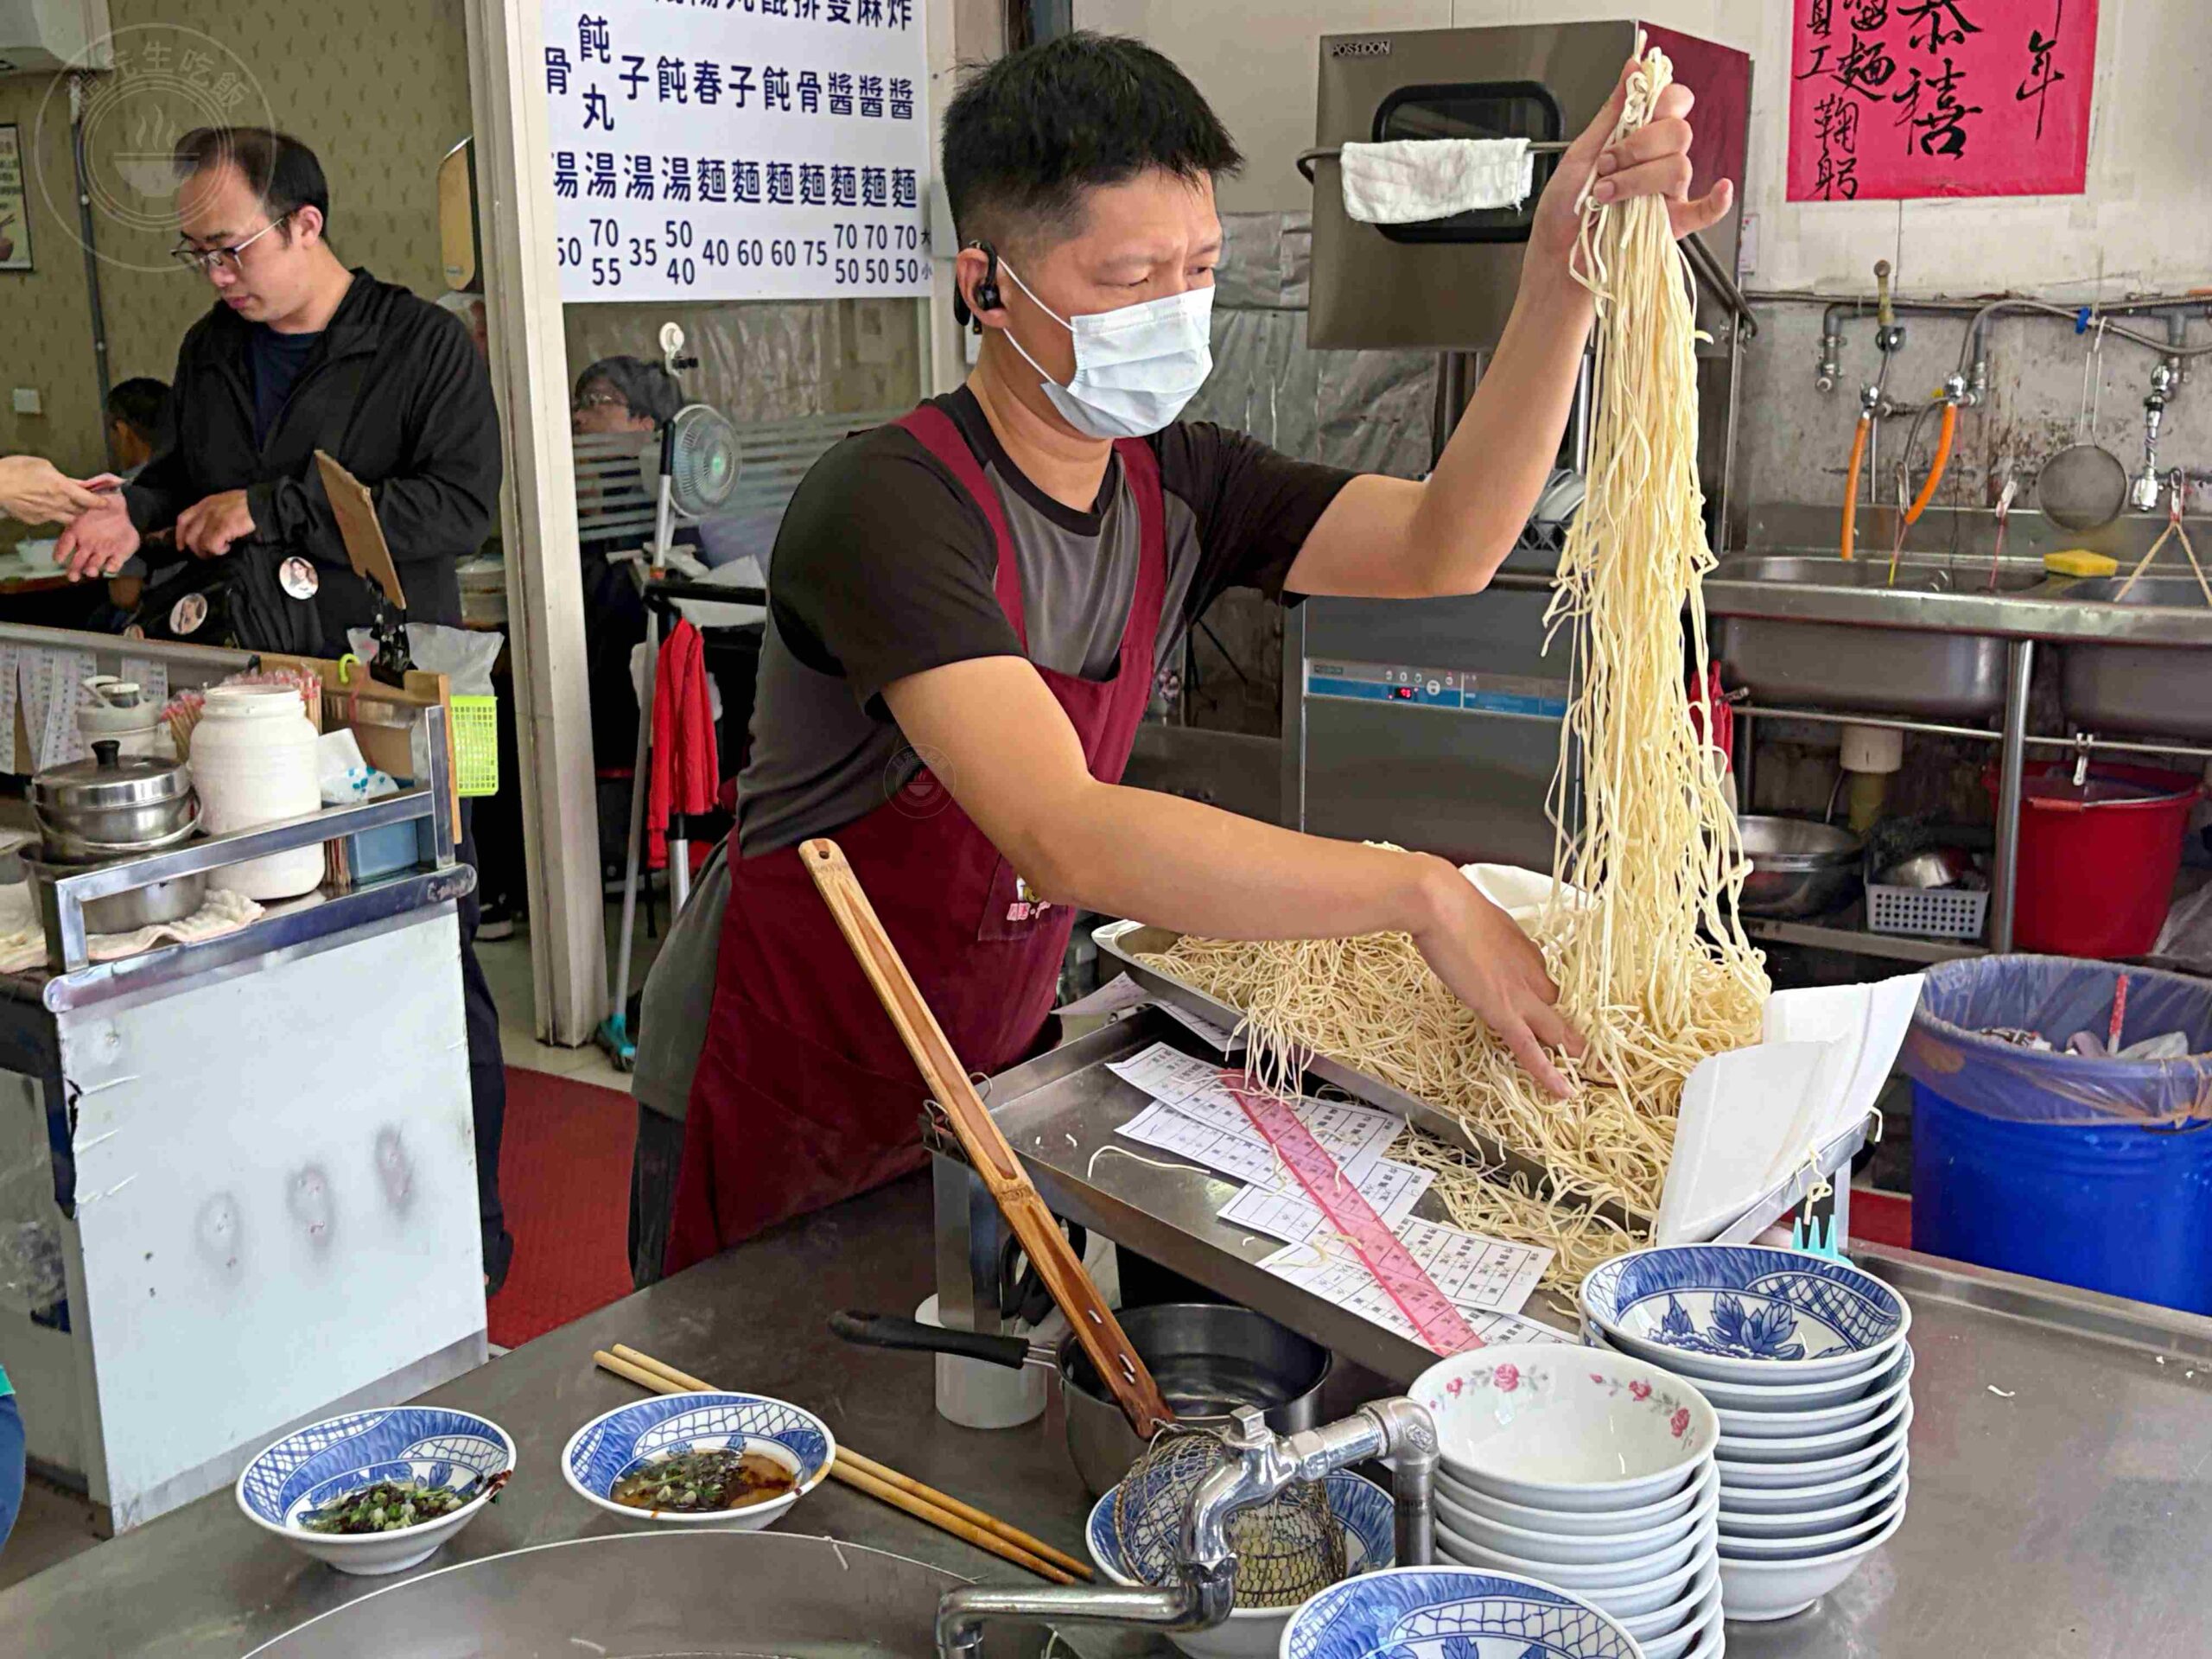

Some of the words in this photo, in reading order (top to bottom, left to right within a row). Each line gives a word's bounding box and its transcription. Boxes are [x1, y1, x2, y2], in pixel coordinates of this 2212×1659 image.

[589, 219, 619, 248] 70
[665, 220, 693, 249] 50
[834, 224, 858, 250] 70
[864, 225, 887, 251] 70
[894, 225, 918, 251] 70
[629, 238, 658, 266] 35
[702, 239, 729, 266] 40
[737, 239, 763, 266] 60
[771, 240, 797, 267] 60
[804, 240, 828, 266] 75
[592, 257, 621, 286] 55
[666, 257, 696, 286] 40
[835, 258, 860, 284] 50
[865, 258, 889, 284] 50
[895, 258, 918, 284] 50
